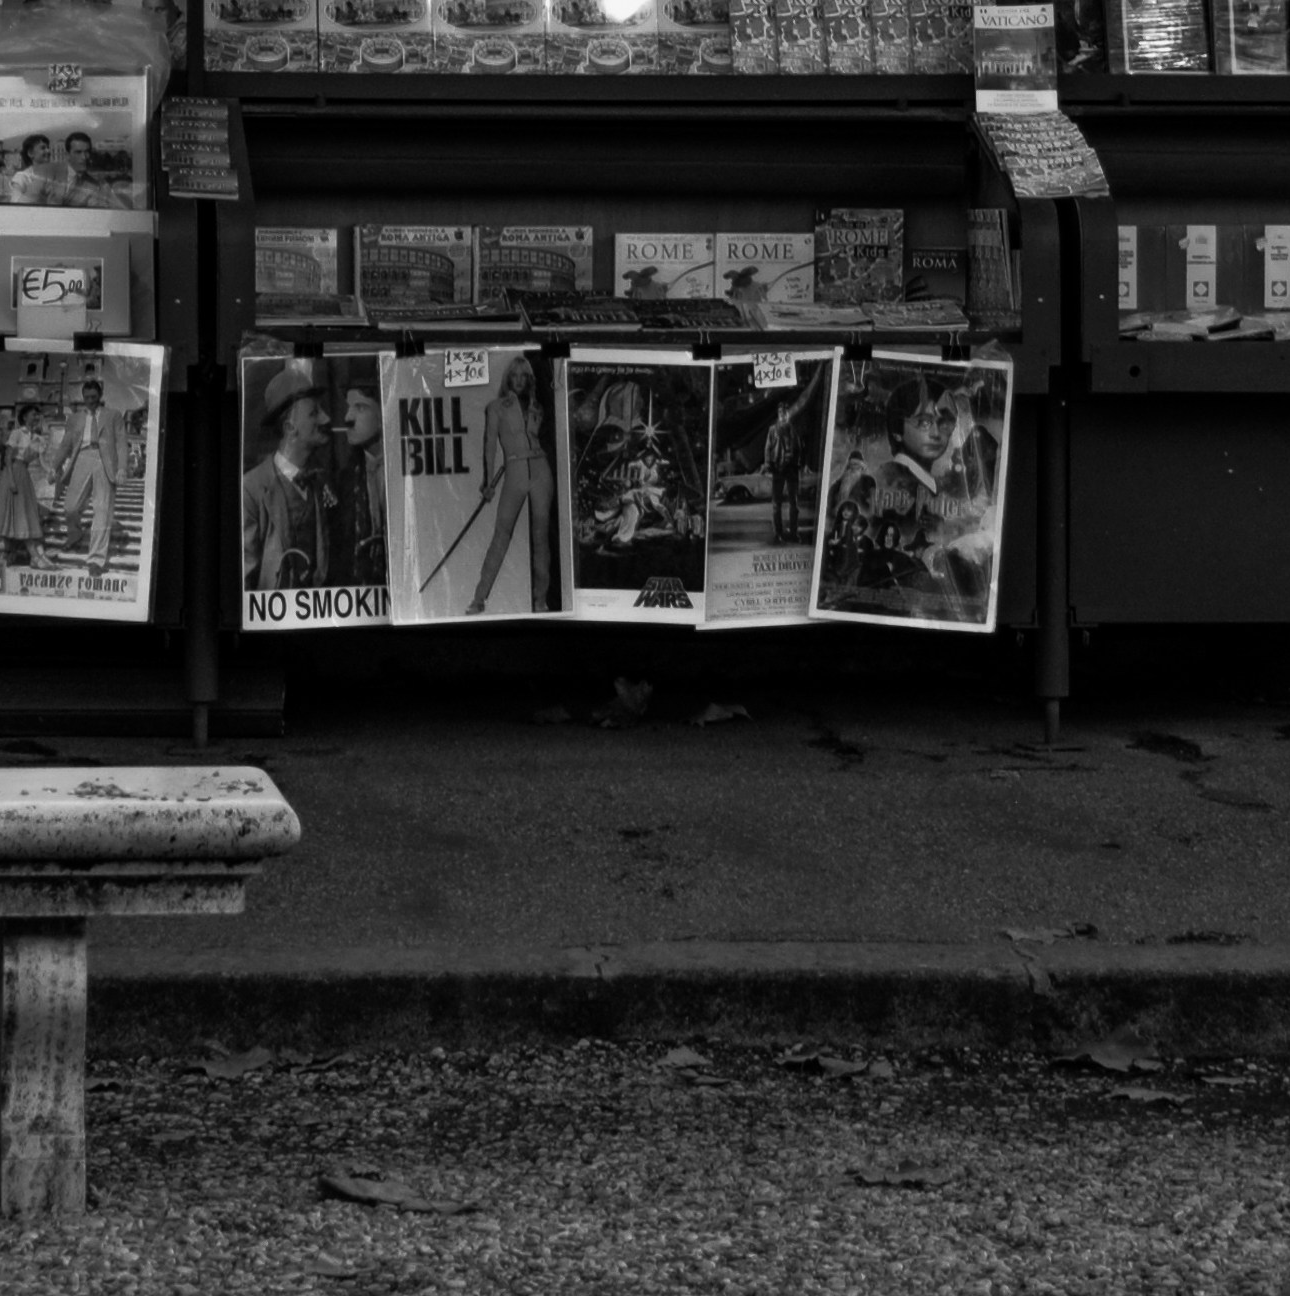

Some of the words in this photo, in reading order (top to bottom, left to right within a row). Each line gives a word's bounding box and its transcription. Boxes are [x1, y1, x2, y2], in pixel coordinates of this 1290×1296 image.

[981, 13, 1048, 27] VATICANO
[835, 229, 886, 245] ROME
[627, 243, 694, 260] ROME
[727, 242, 795, 260] ROME
[912, 257, 957, 269] ROMA
[399, 397, 468, 435] KILL
[401, 436, 470, 477] BILL
[19, 572, 73, 589] vacanze
[78, 576, 128, 593] romane
[641, 576, 685, 591] STAR
[249, 591, 287, 622] NO
[633, 590, 694, 609] WARS
